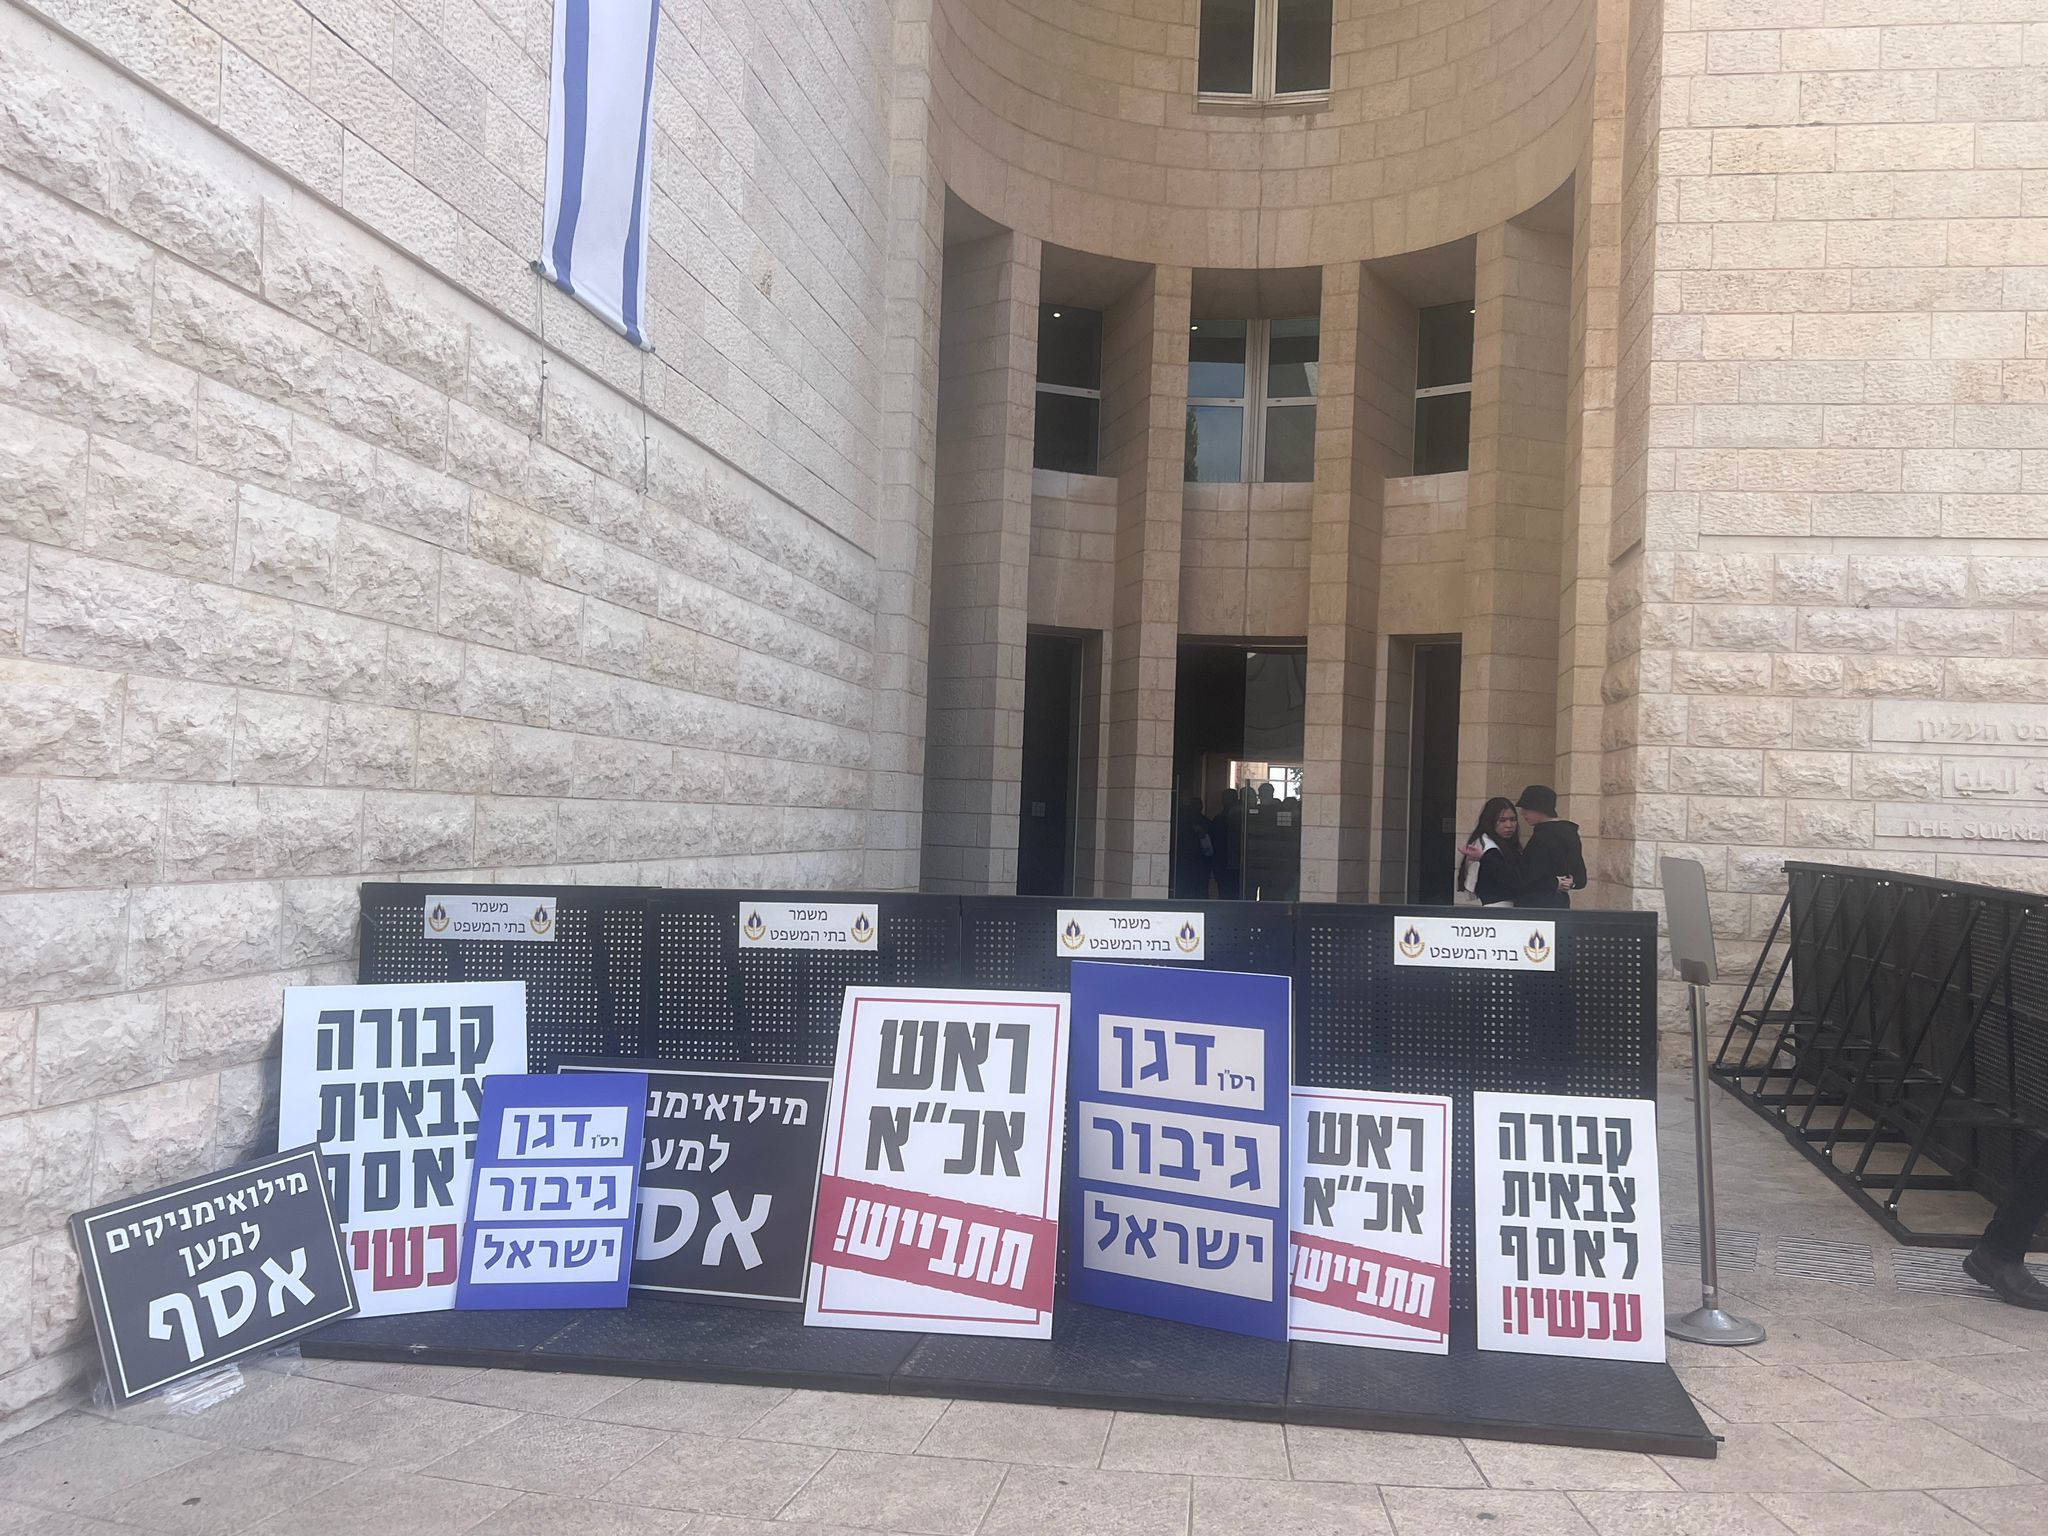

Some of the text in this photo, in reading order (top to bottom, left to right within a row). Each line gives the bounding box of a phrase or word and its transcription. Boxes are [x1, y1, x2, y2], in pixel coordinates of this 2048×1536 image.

[1917, 718, 2000, 742] העליון
[1906, 820, 1950, 838] THE
[454, 919, 502, 933] המשפט
[472, 901, 509, 914] משמר
[502, 920, 526, 934] בתי
[788, 908, 828, 921] משמר
[1108, 917, 1151, 930] משמר
[770, 928, 820, 941] המשפט
[821, 929, 847, 942] בתי
[1089, 937, 1143, 951] המשפט
[1145, 938, 1171, 951] בתי
[1451, 925, 1496, 938] משמר
[1430, 947, 1487, 959] המשפט
[1490, 949, 1519, 961] בתי
[316, 1005, 494, 1074] קבורה
[876, 1019, 1030, 1095] ראש
[1113, 1026, 1215, 1088] דגן
[646, 1089, 808, 1126] מילואימנ
[514, 1114, 592, 1155] דגן
[642, 1134, 730, 1173] למע
[1092, 1117, 1261, 1191] גיבור
[1307, 1110, 1424, 1173] ראש
[1499, 1112, 1633, 1174] קבורה
[106, 1172, 309, 1254] מילואימניקים
[489, 1176, 617, 1212] גיבור
[1501, 1171, 1636, 1223] צבאית
[635, 1187, 773, 1271] אס
[832, 1196, 1034, 1291] תתבייש!
[1094, 1200, 1264, 1270] ישראל
[179, 1221, 261, 1278] למען
[341, 1222, 467, 1292] כשי
[484, 1234, 615, 1270] ישראל
[1499, 1225, 1639, 1281] לאסף
[149, 1247, 316, 1362] אסף
[1502, 1286, 1642, 1342] עכשיו!
